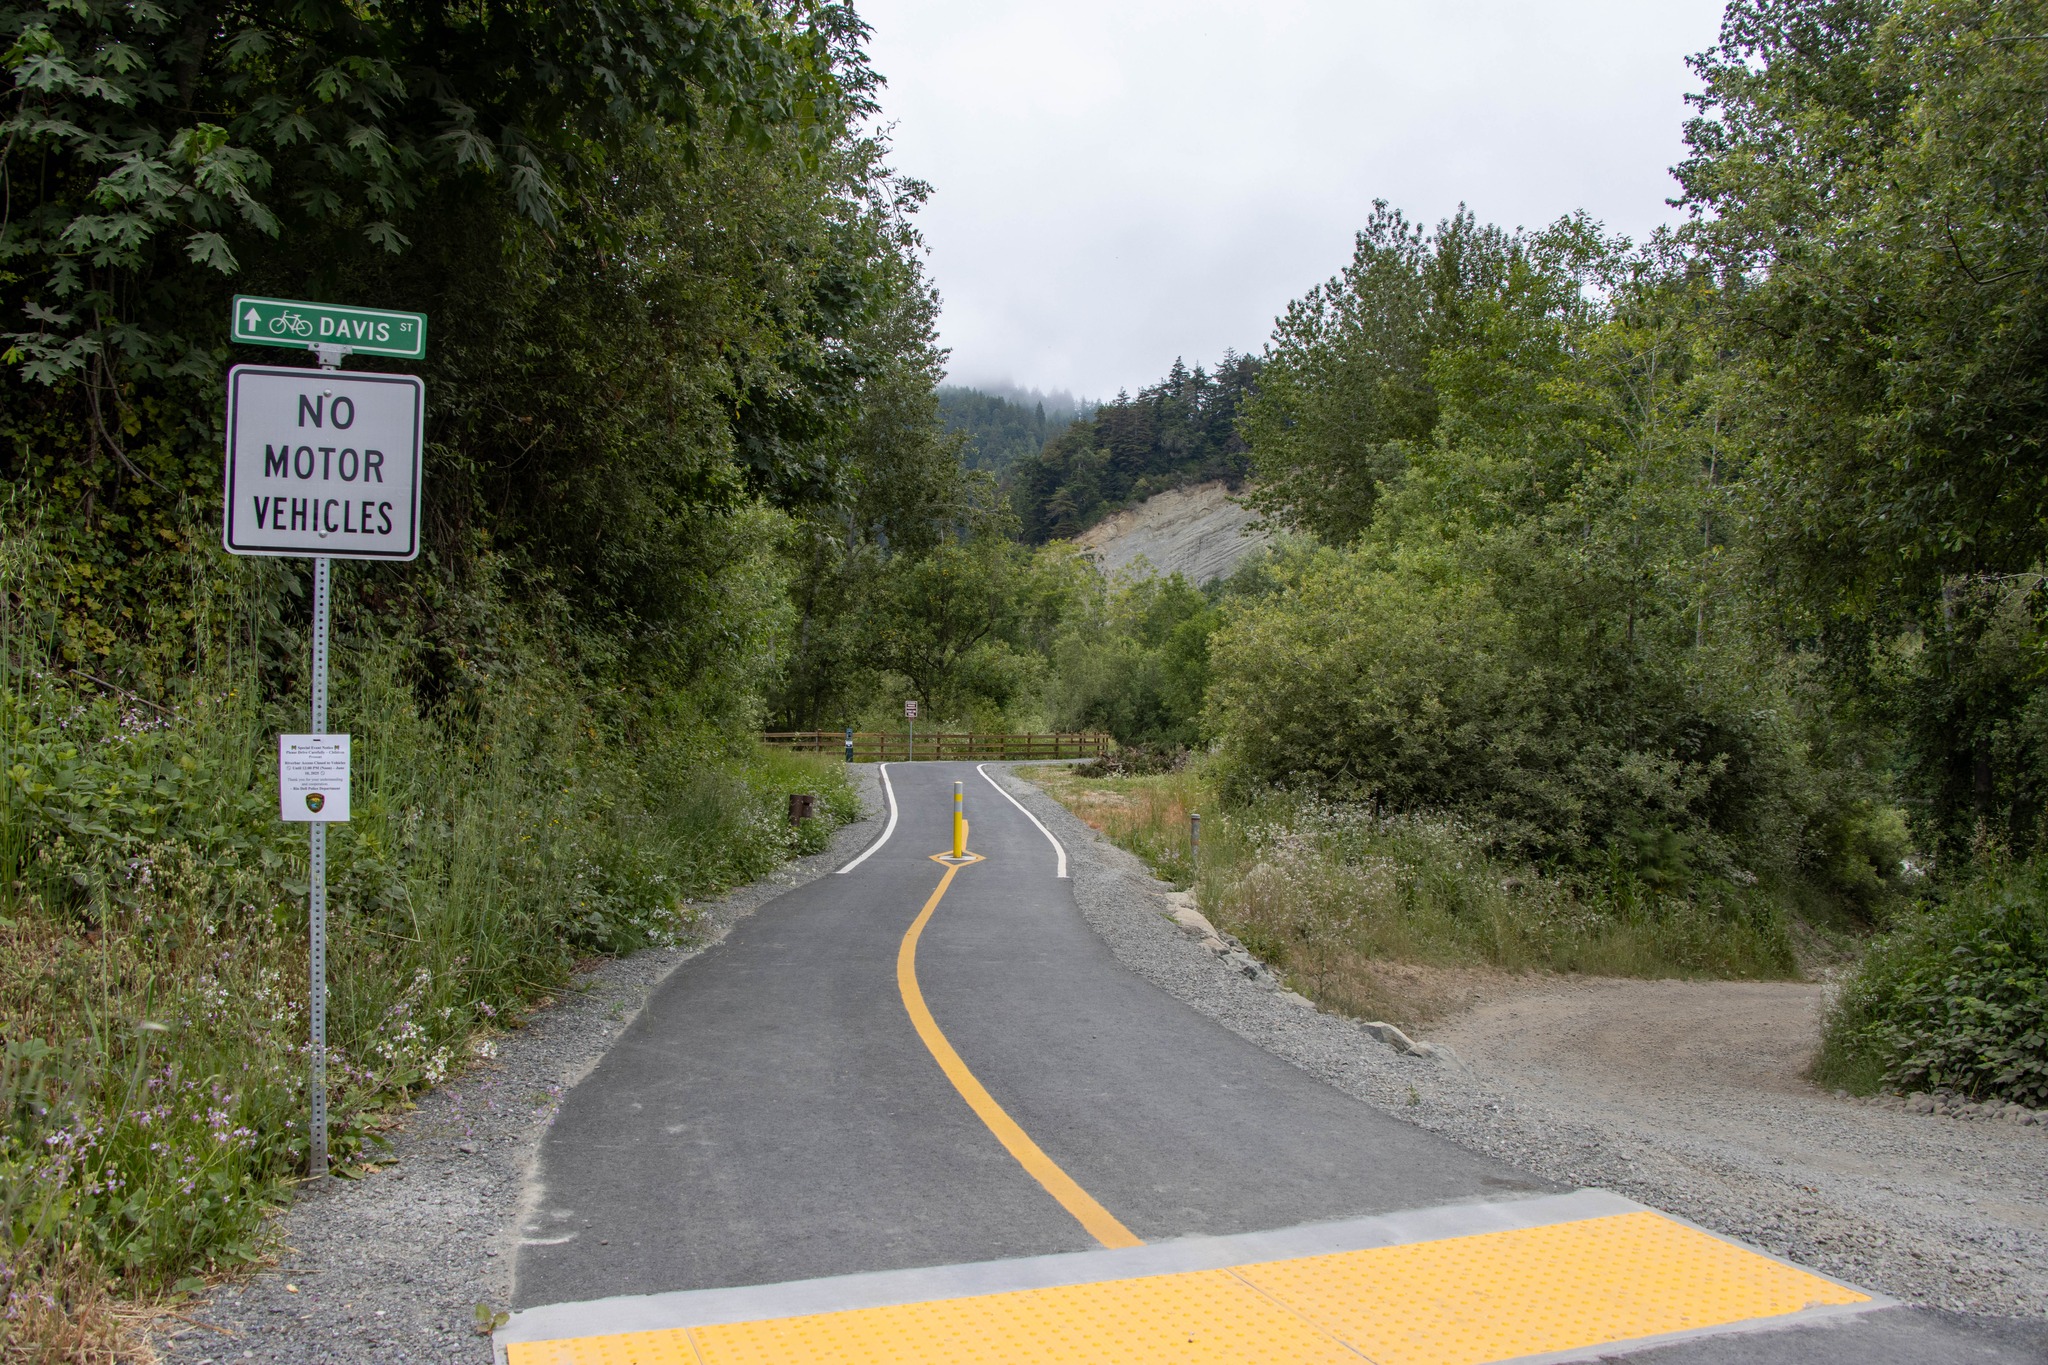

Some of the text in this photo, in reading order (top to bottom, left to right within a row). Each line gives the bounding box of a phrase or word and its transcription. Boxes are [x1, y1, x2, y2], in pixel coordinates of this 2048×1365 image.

[319, 316, 413, 342] DAVIS ST
[297, 394, 355, 430] NO
[264, 444, 385, 483] MOTOR
[253, 495, 392, 535] VEHICLES
